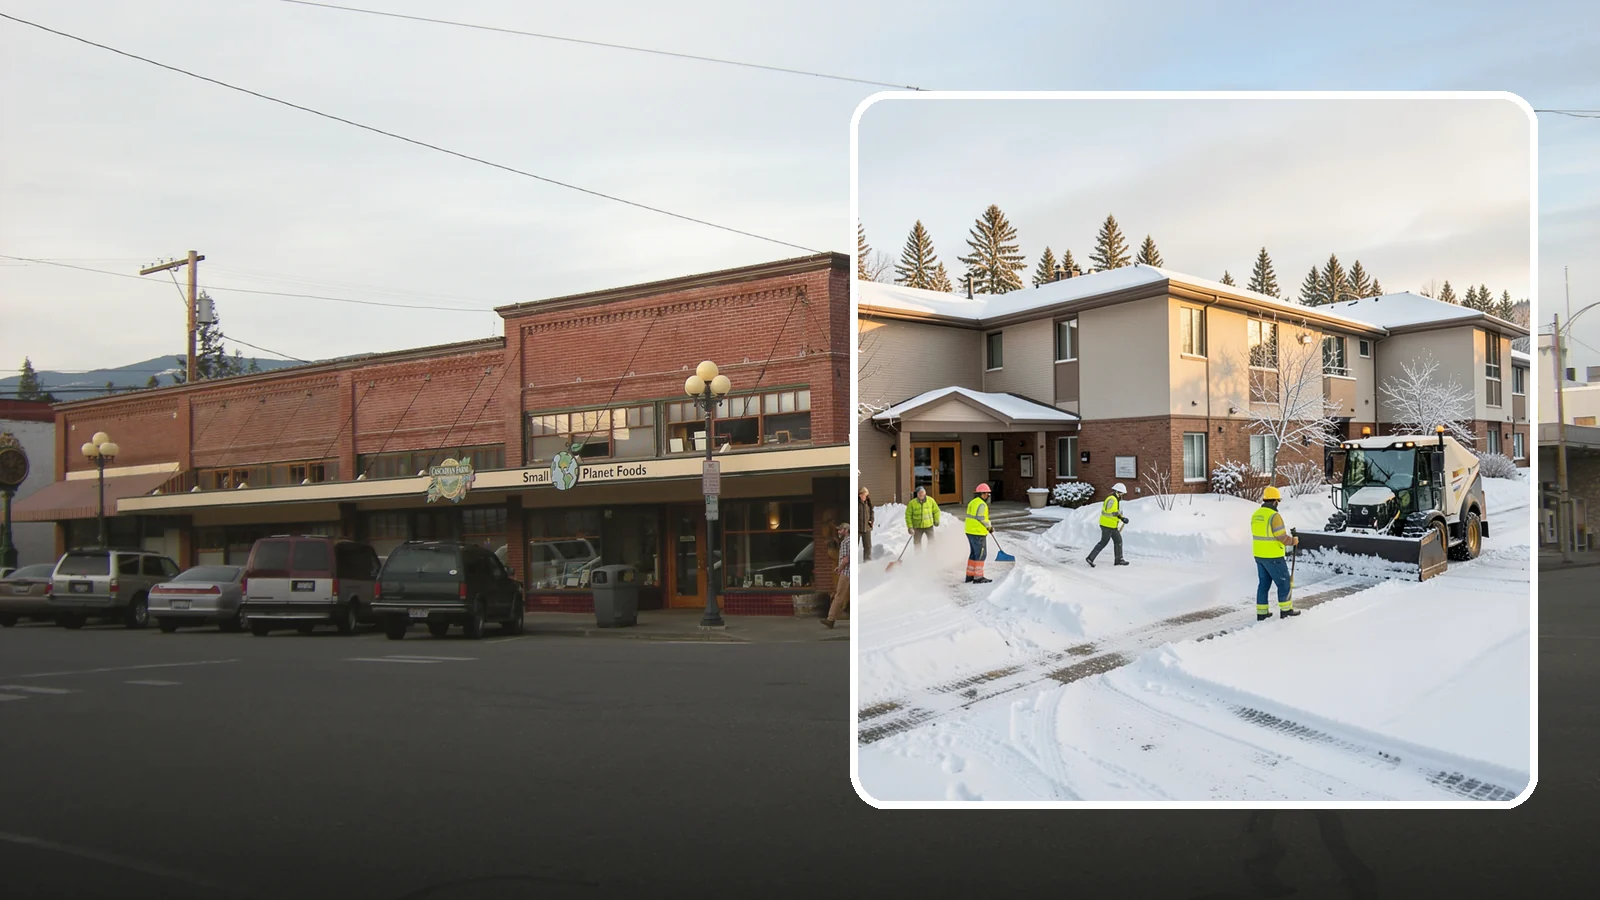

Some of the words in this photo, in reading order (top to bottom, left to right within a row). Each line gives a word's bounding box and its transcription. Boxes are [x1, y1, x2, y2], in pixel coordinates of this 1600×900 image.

[431, 466, 456, 476] CASCADIAN
[456, 465, 469, 474] FARM
[523, 471, 549, 483] Small
[583, 467, 614, 479] Planet
[617, 464, 647, 477] Foods
